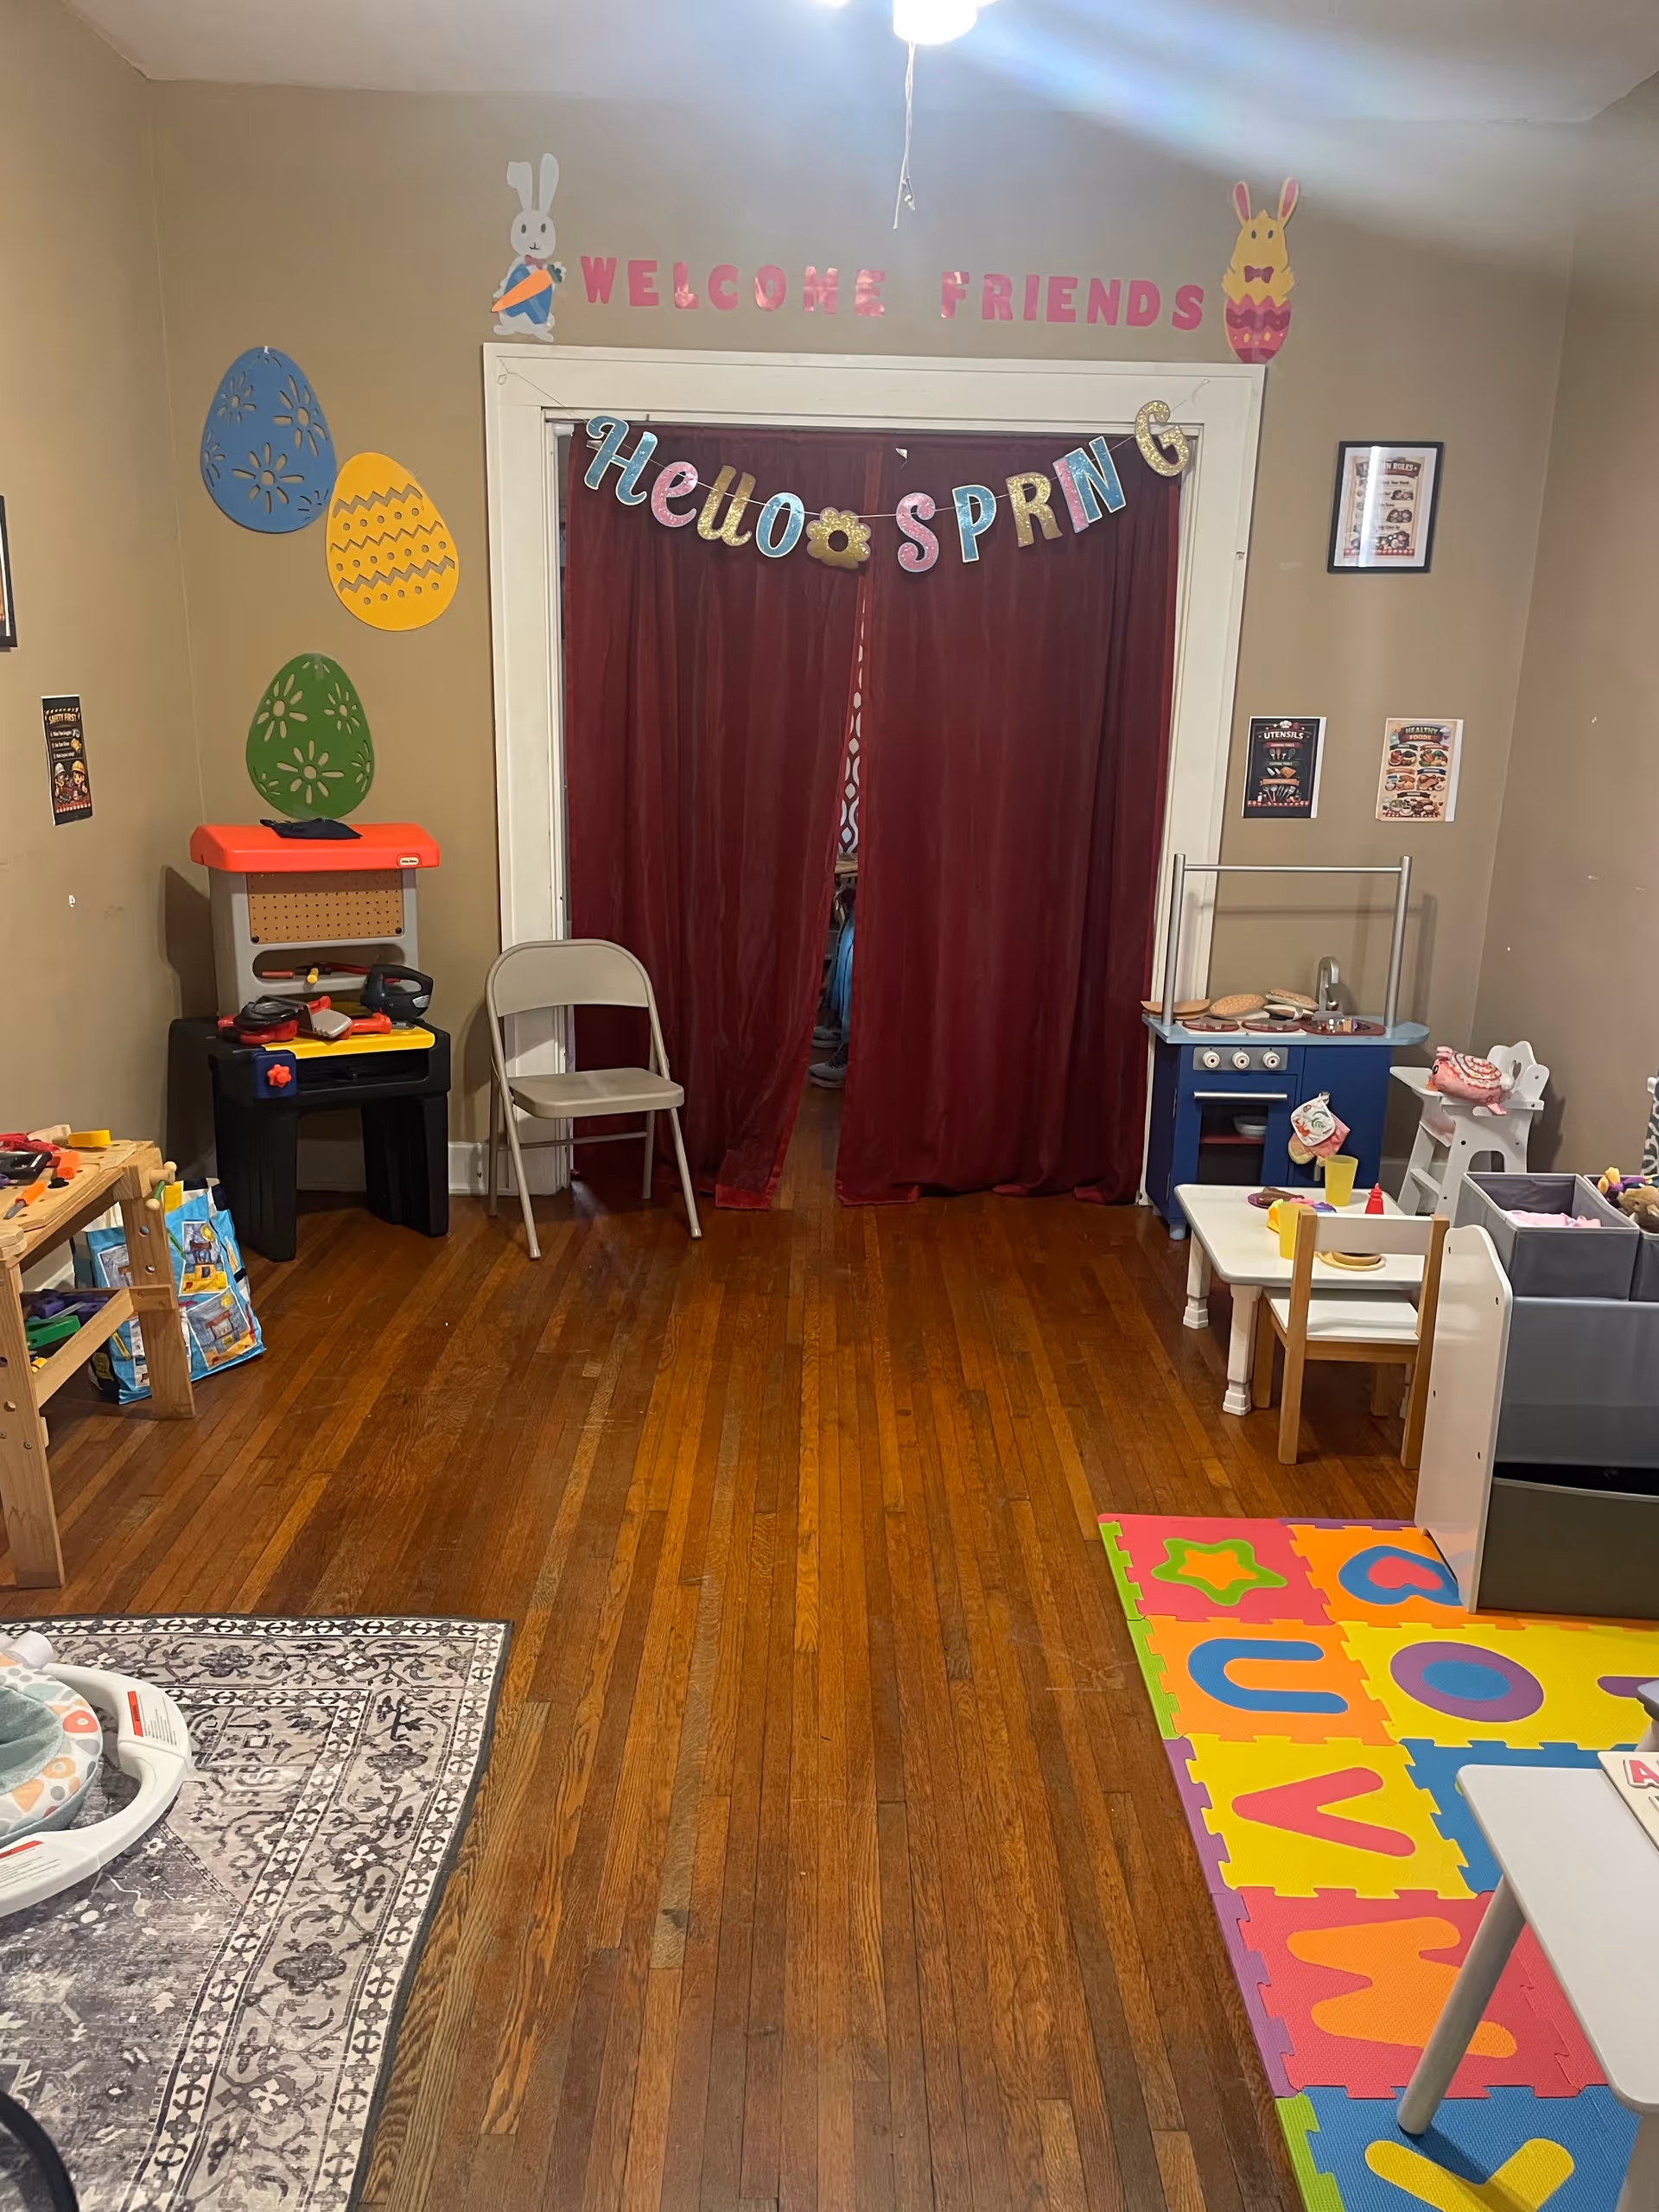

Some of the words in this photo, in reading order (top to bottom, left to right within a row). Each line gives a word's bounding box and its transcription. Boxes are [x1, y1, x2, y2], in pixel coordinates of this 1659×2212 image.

[580, 255, 887, 318] WELCOME
[940, 270, 1206, 332] FRIENDS
[1393, 462, 1414, 471] RULES
[585, 415, 805, 558] Hello
[895, 400, 1192, 573] SPRING
[48, 714, 64, 725] SAFETY
[64, 713, 77, 722] FIRST
[1263, 731, 1305, 740] UTENSILS
